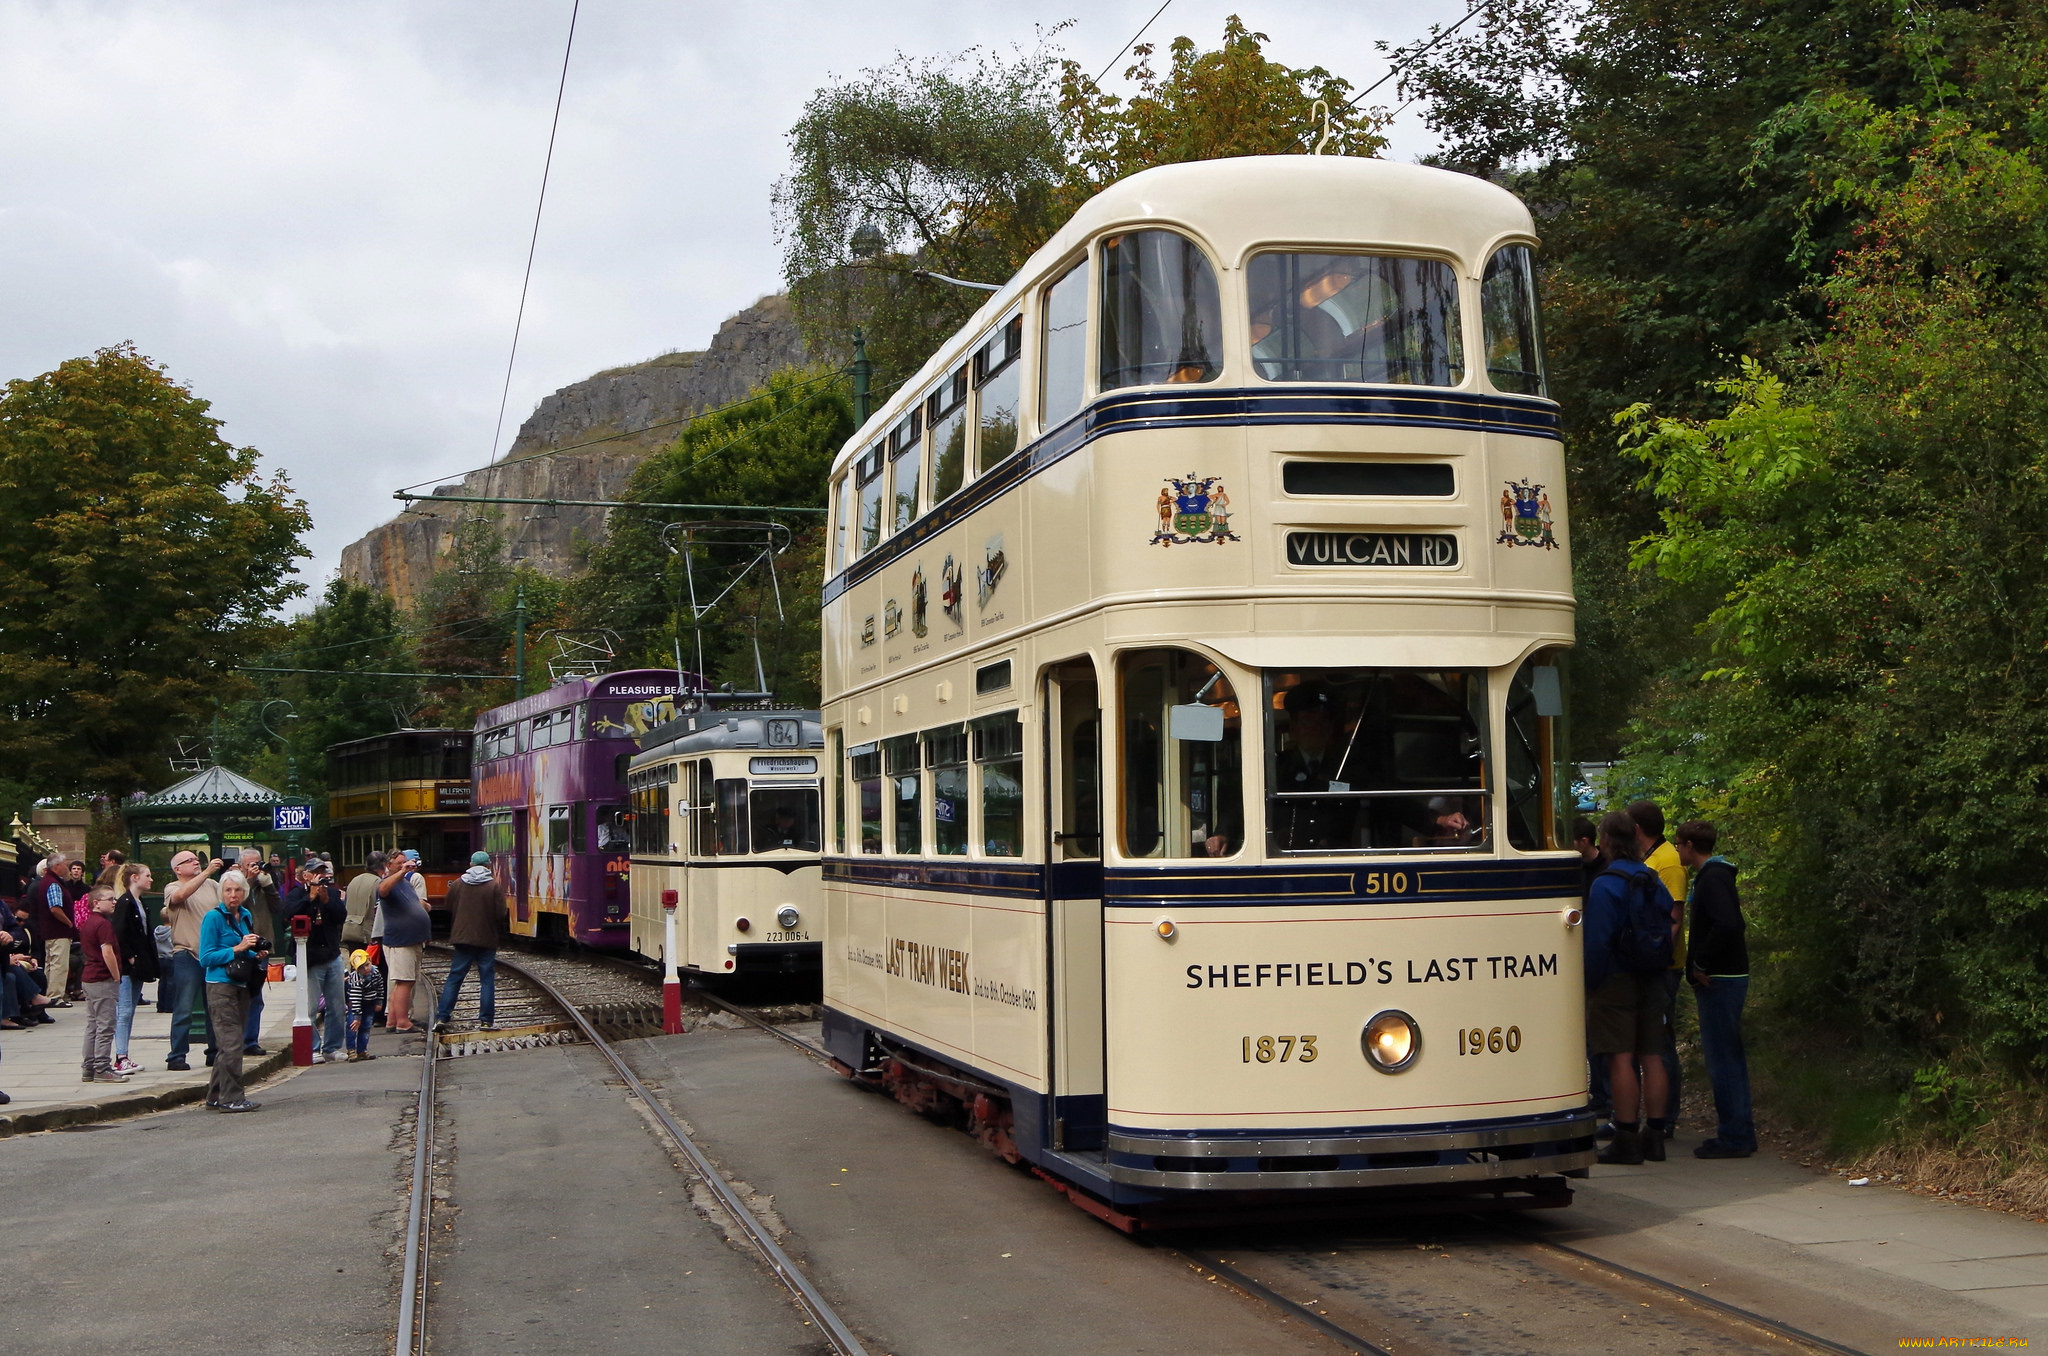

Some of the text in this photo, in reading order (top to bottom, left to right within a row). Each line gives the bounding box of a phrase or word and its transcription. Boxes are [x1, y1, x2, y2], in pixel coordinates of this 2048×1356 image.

[1292, 535, 1453, 566] VULCAN RD
[609, 686, 662, 695] PLEASURE
[279, 810, 306, 825] STOP
[1366, 872, 1408, 894] 510
[766, 931, 809, 942] 223 006-4
[885, 936, 970, 996] LAST TRAM WEEK
[1186, 953, 1557, 988] SHEFFIELD'S LAST TRAM
[1022, 988, 1036, 1011] 1960
[1242, 1025, 1522, 1063] 1873 1960
